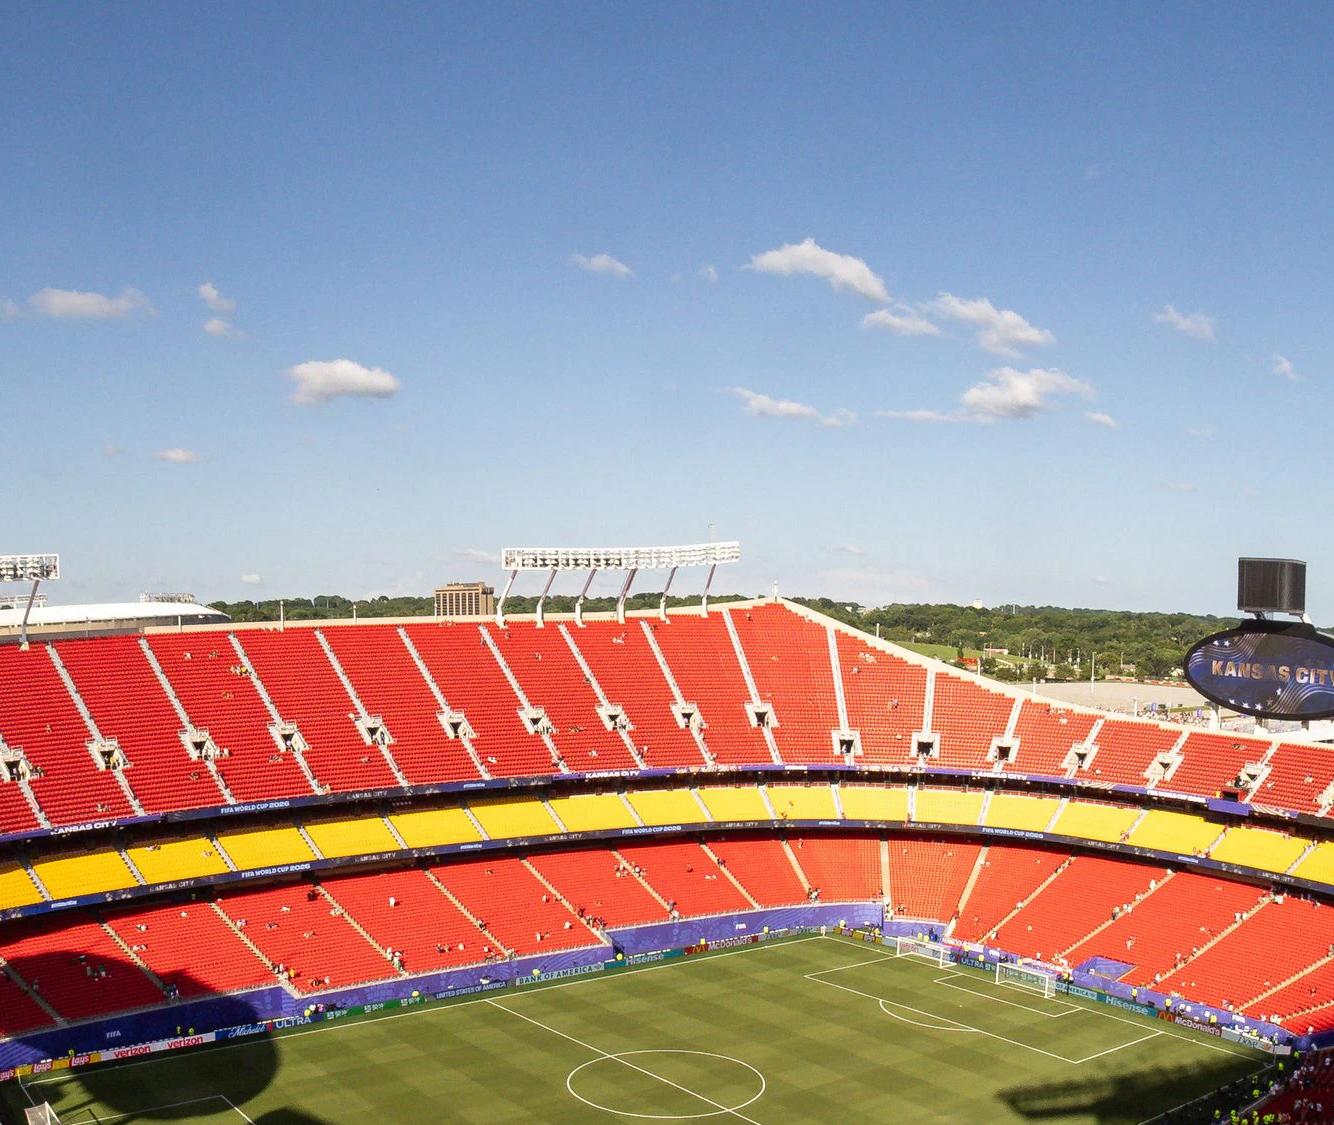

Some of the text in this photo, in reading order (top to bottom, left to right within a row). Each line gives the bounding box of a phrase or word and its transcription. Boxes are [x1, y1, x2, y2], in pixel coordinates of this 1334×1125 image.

[1212, 659, 1291, 682] KANSAS
[585, 770, 640, 779] KANSAS CITY
[220, 800, 290, 815] FIFA WORLD CUP 2026
[94, 820, 118, 830] CITY
[994, 828, 1013, 836] WORLD
[1025, 831, 1044, 839] 2026
[241, 871, 255, 879] FIFA
[255, 868, 277, 877] WORLD
[290, 863, 311, 872] 2026
[708, 936, 753, 951] McDonald's
[625, 953, 665, 966] Hisense
[961, 957, 984, 969] ULTRA
[520, 965, 593, 985] BANK OF AMERICA
[436, 981, 506, 1000] UNITED STATES OF AMERICA
[1106, 995, 1149, 1015] Hisense
[227, 1016, 312, 1039] Michelob ULTRA
[1174, 1016, 1220, 1036] McDonald's
[107, 1031, 121, 1039] FIFA
[114, 1035, 203, 1059] verizon verizon
